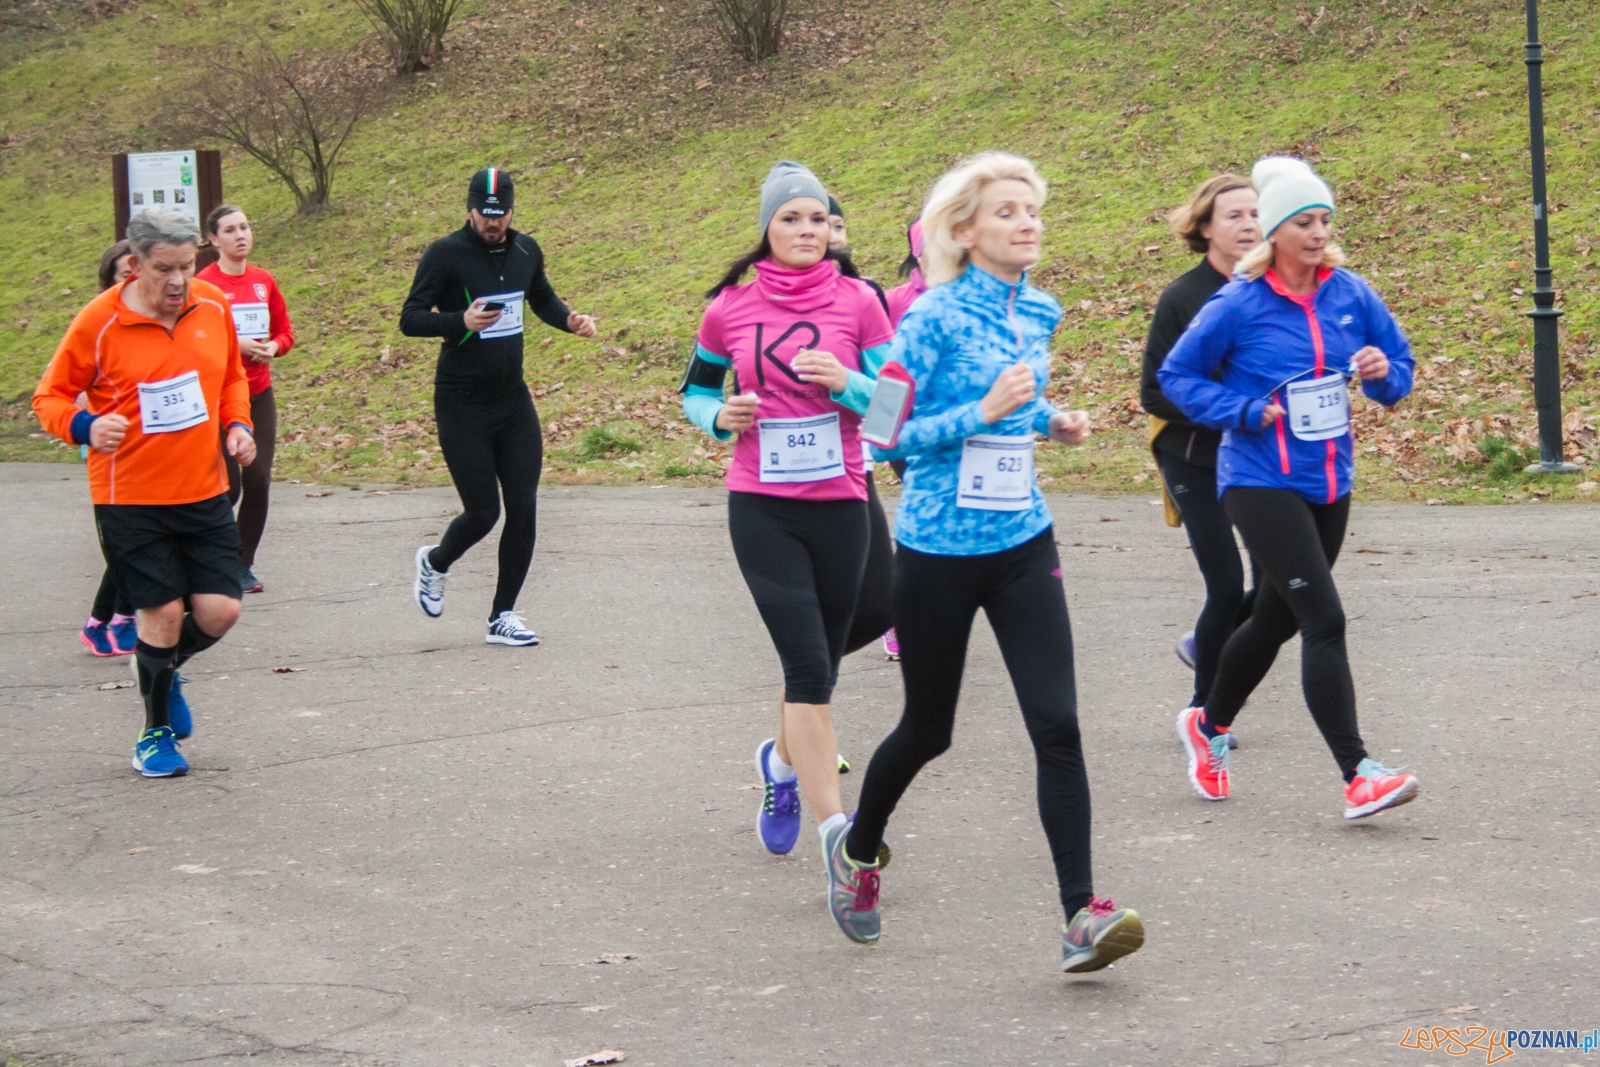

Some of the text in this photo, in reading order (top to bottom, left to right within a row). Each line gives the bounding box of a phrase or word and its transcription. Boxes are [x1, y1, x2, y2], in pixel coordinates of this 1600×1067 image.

[244, 313, 258, 322] 769
[503, 305, 514, 315] 91
[162, 391, 186, 407] 331
[1317, 391, 1341, 409] 219
[787, 432, 817, 448] 842
[997, 456, 1023, 473] 623
